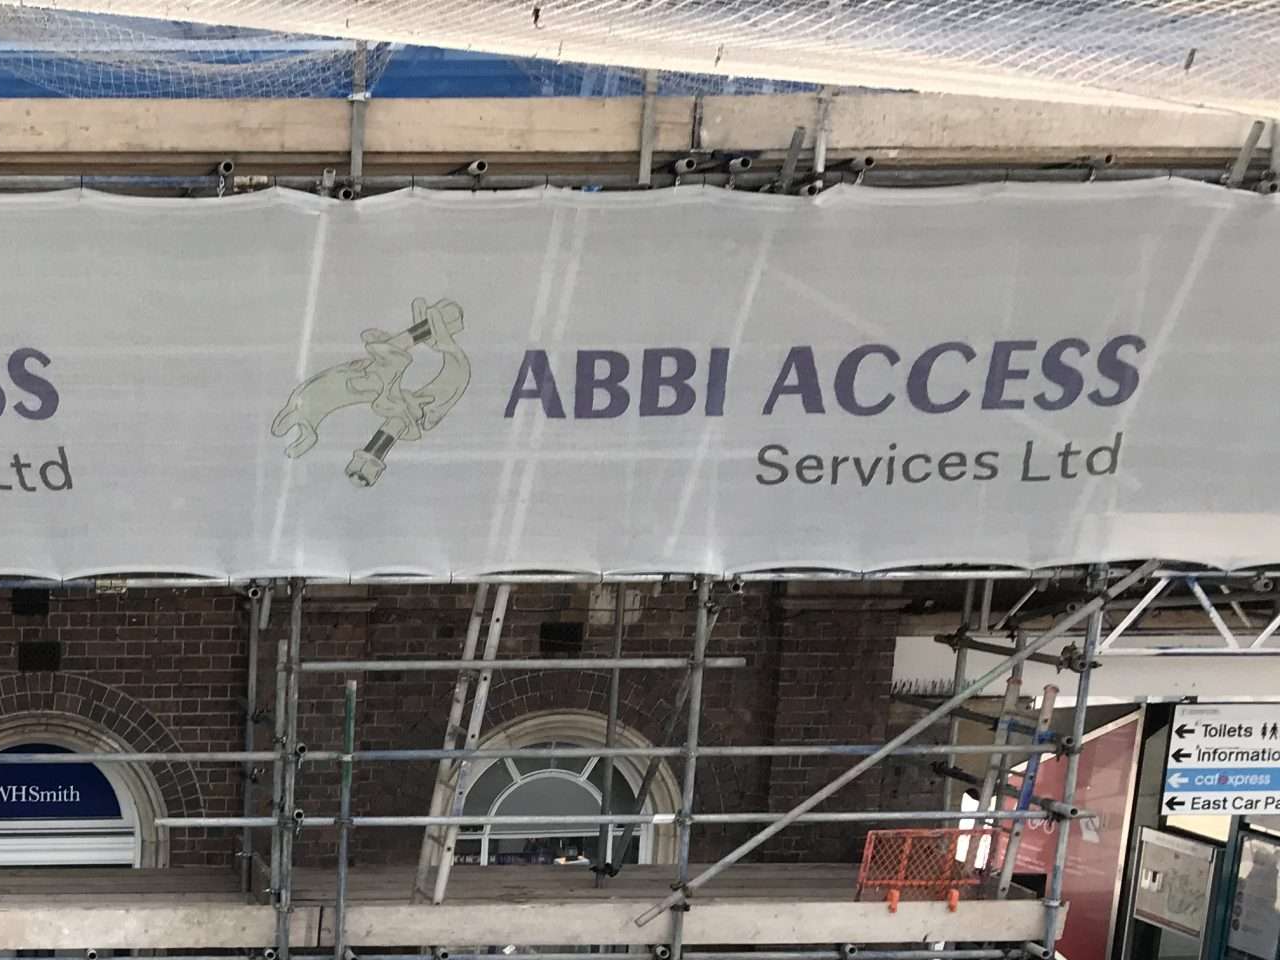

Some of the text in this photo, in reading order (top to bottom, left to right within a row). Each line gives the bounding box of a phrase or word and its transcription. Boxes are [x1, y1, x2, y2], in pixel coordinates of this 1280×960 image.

[503, 333, 1148, 419] ABBI ACCESS
[755, 432, 1123, 487] Services Ltd
[1202, 724, 1253, 738] Toilets
[1190, 797, 1228, 810] East
[1232, 796, 1261, 810] Car
